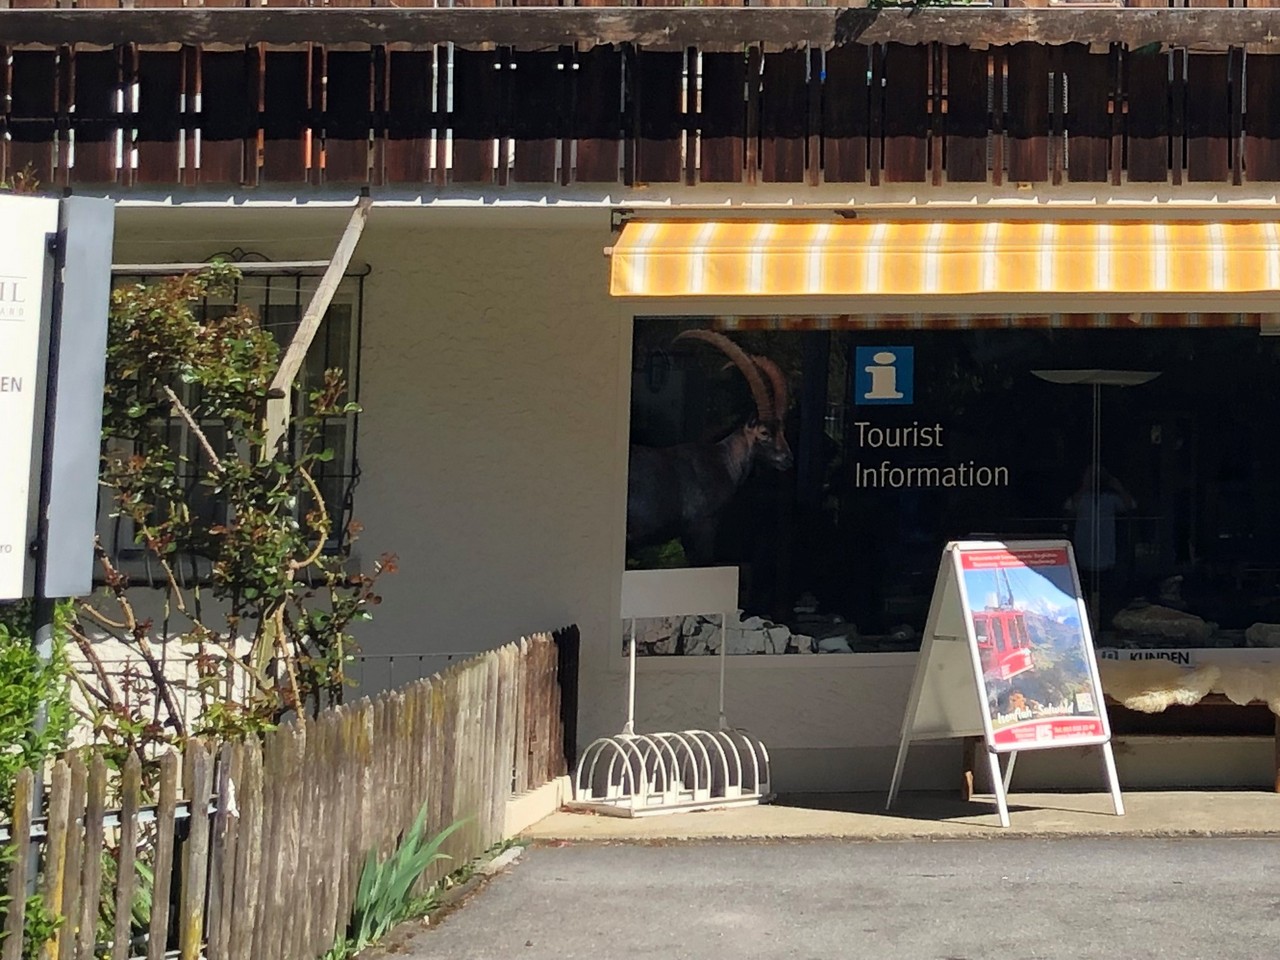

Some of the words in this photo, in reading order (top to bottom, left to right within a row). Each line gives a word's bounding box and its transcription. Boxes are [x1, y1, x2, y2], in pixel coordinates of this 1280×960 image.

[1, 376, 22, 392] EN
[854, 421, 944, 448] Tourist
[855, 460, 1009, 488] Information
